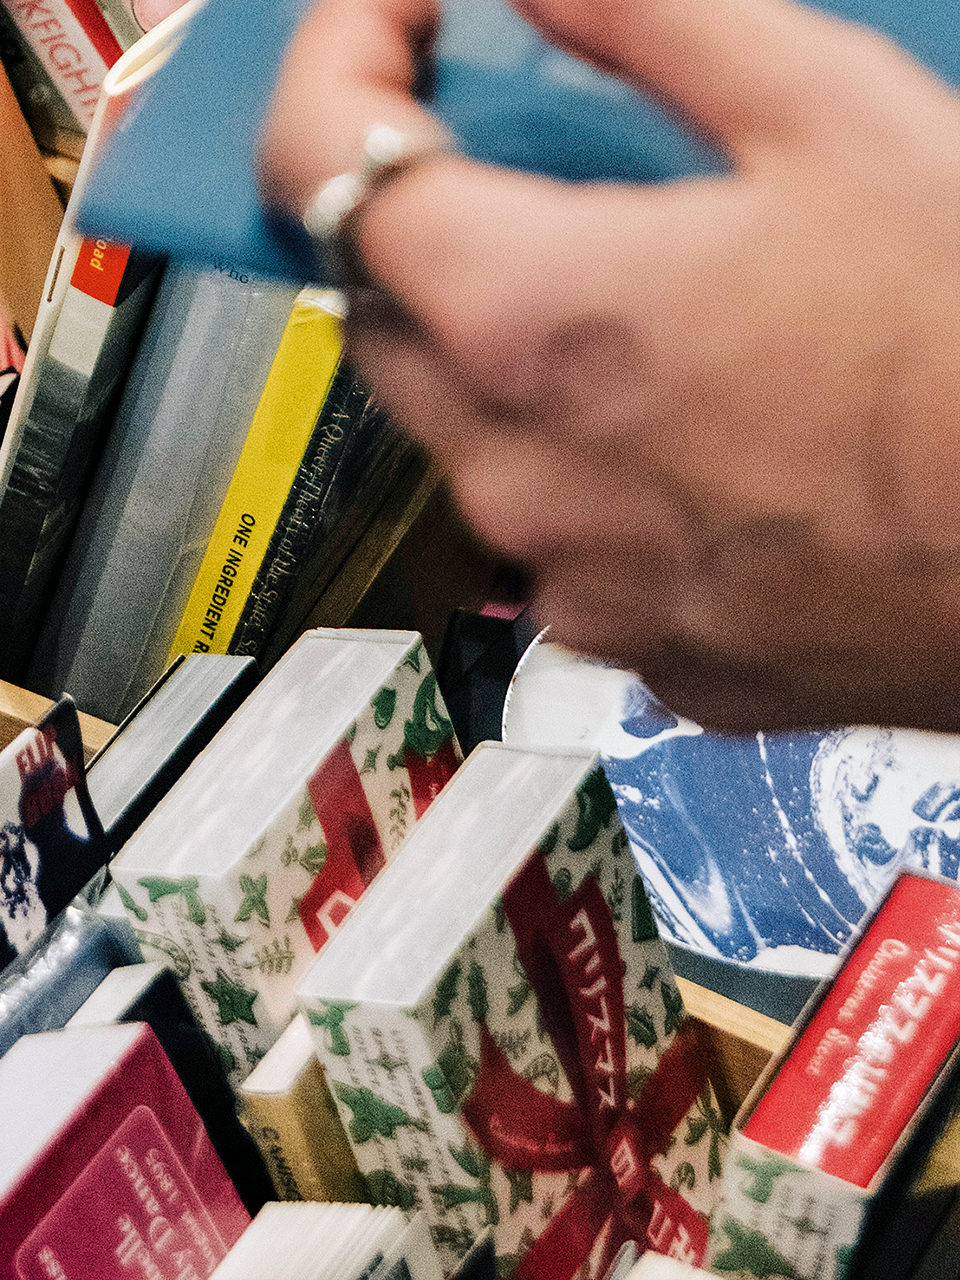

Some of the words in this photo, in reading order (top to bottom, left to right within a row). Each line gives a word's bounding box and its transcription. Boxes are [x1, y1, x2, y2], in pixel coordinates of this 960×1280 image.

[90, 238, 110, 271] oad
[310, 422, 344, 473] Queer
[233, 513, 255, 548] ONE
[199, 549, 244, 640] INGREDIENT
